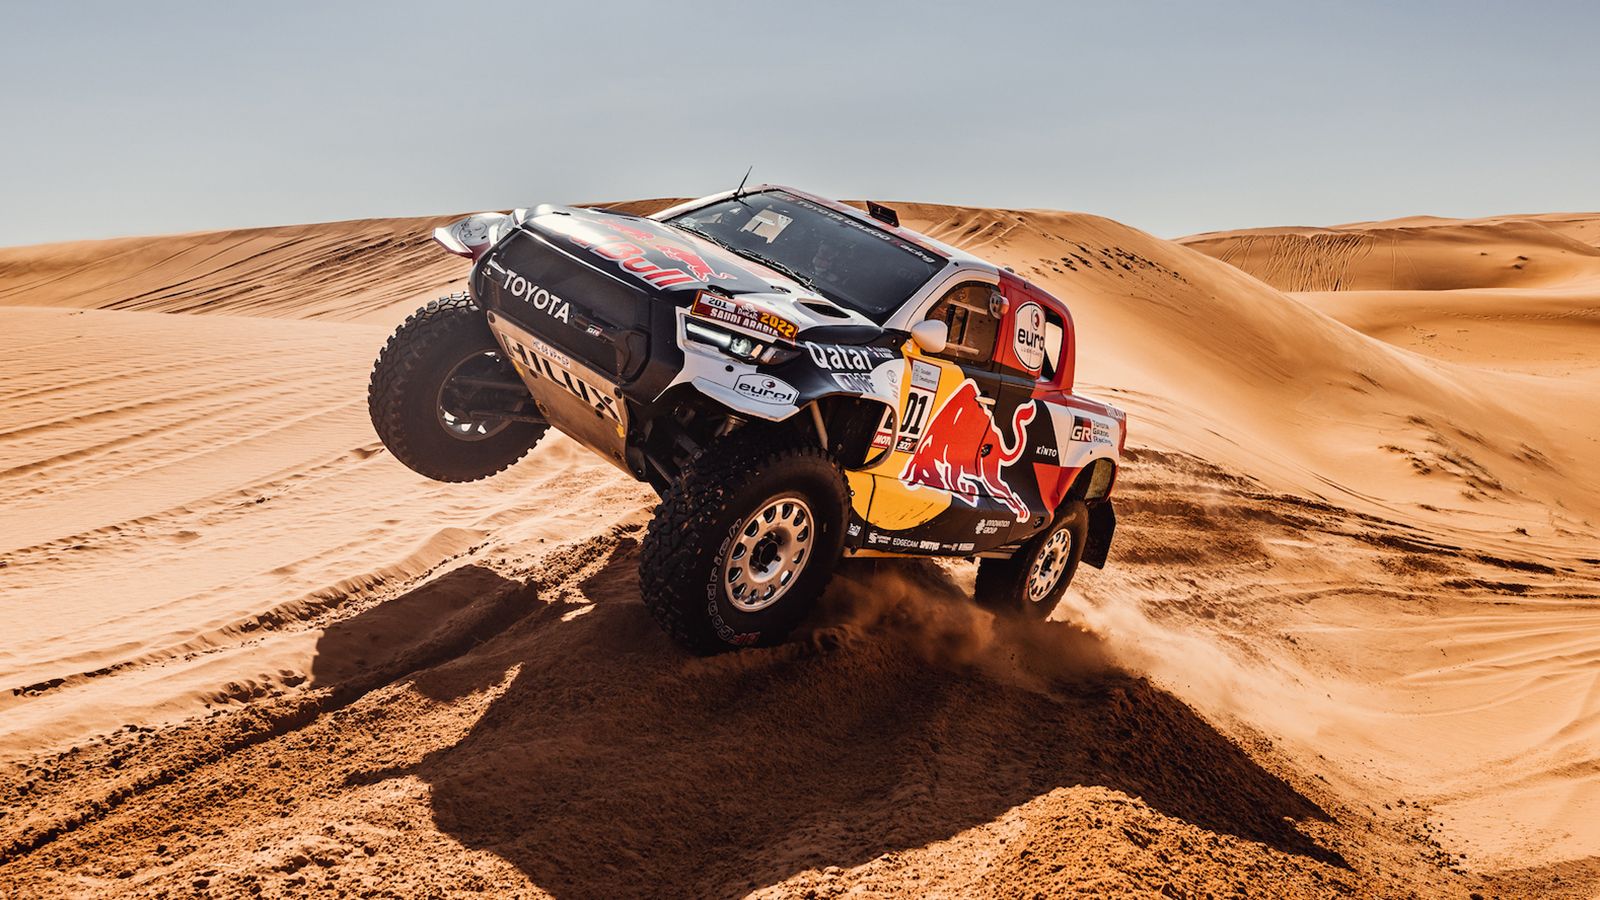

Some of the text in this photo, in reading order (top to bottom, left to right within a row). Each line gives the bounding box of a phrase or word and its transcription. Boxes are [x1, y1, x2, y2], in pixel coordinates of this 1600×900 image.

[798, 199, 844, 221] TOYOTA
[844, 219, 891, 241] GAZOO
[591, 242, 698, 289] Bull
[503, 269, 570, 324] TOYOTA
[708, 297, 727, 309] 201
[710, 308, 780, 337] SAUDI ARABIA
[760, 312, 795, 337] 2022
[1017, 328, 1045, 351] euro
[804, 341, 874, 371] Qatar
[502, 334, 621, 423] HILUX
[739, 383, 793, 401] eurol
[1071, 426, 1092, 442] GR
[892, 537, 920, 547] EDGECAM
